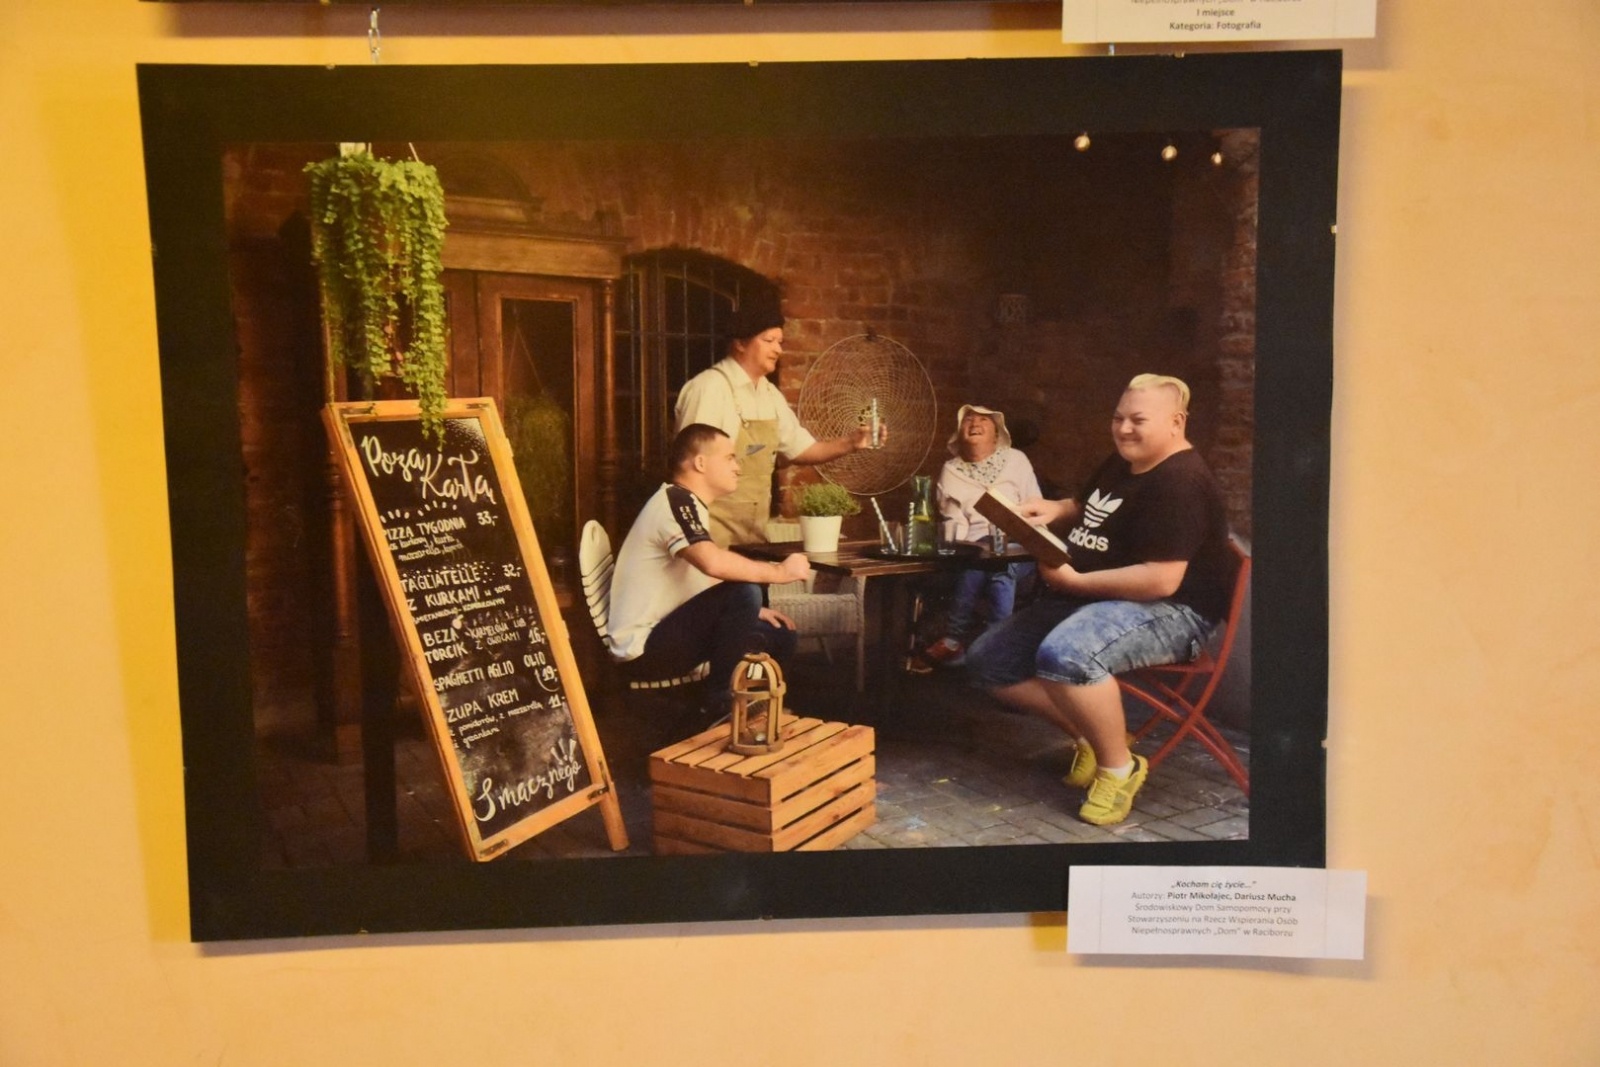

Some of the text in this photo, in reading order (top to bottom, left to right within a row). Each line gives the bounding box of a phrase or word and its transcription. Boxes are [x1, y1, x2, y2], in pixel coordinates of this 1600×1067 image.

[1196, 8, 1235, 18] I miejsce
[1169, 21, 1262, 31] Kategoria: Fotografia
[360, 435, 425, 482] Poza
[416, 516, 467, 536] TYGODNIA
[400, 565, 481, 593] TAGLIATELLE
[425, 585, 480, 608] KURKAMI
[423, 627, 460, 648] BEZA
[424, 641, 469, 665] TORCIK
[433, 651, 547, 692] SPAGHETTI AGLIO OLIO
[446, 700, 483, 724] ZUPA
[487, 688, 520, 709] KREM
[473, 760, 582, 822] Smacznego
[1210, 880, 1223, 889] cię
[1131, 892, 1164, 900] Autorzy:
[1167, 891, 1188, 899] Piotr
[1234, 892, 1266, 900] Dariusz
[1267, 893, 1297, 901] Mucha
[1195, 903, 1215, 911] Dom
[1217, 904, 1271, 913] Samopomocy
[1273, 906, 1292, 914] przy
[1127, 914, 1190, 923] Stowarzyszeniu
[1204, 915, 1227, 923] Rzecz
[1228, 915, 1275, 925] Wspierania
[1252, 927, 1294, 937] Raciborzu
